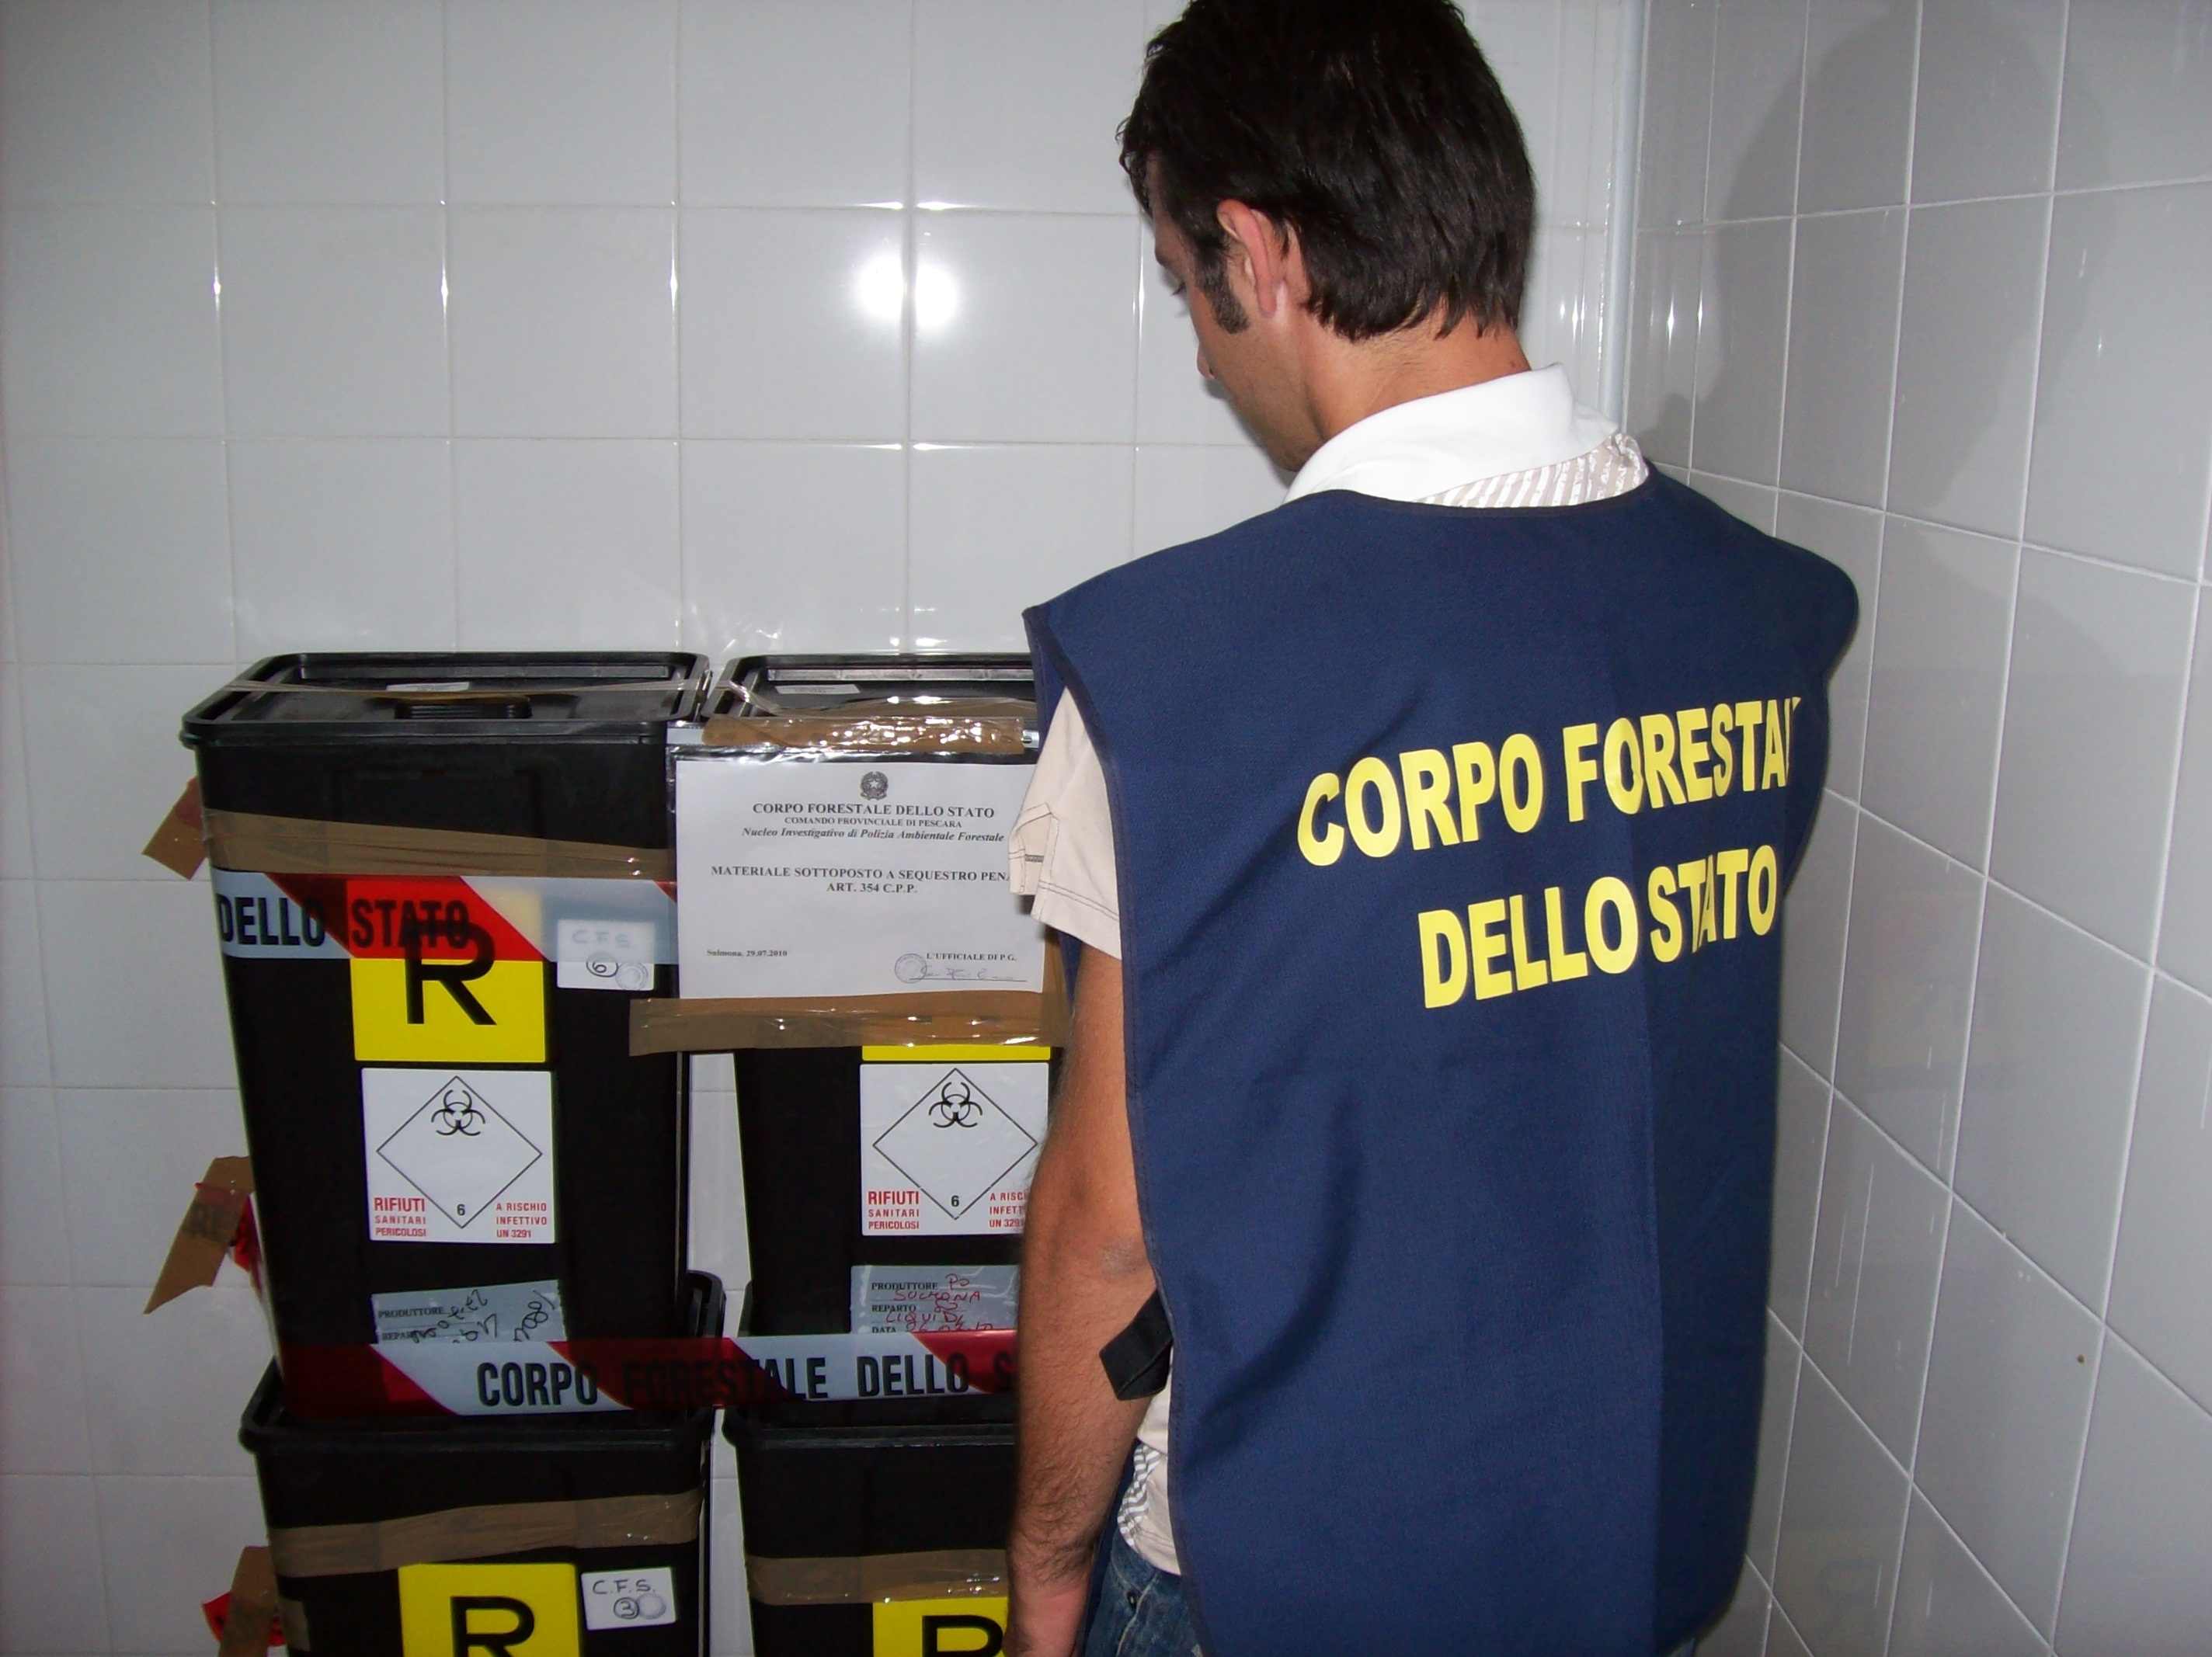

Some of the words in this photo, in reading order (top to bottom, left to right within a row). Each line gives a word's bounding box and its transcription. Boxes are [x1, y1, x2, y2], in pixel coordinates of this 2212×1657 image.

[1298, 733, 1543, 866] CORPO
[1563, 696, 1802, 822] FORESTA
[753, 803, 803, 815] CORPO
[808, 804, 892, 815] FORESTALE
[896, 805, 944, 817] DELLO
[948, 806, 995, 818] STATO
[784, 817, 836, 825] COMANDO
[837, 818, 903, 827] PROVINCIALE
[918, 819, 962, 828] PESCARA
[742, 827, 777, 837] Nucleo
[781, 828, 845, 839] Investigativo
[847, 828, 857, 839] di
[861, 829, 894, 840] Polizia
[898, 830, 955, 841] Ambientale
[958, 832, 1005, 842] Forestale
[711, 865, 791, 877] MATERIALE
[795, 867, 882, 879] SOTTOPOSTO
[886, 869, 894, 879] A
[899, 870, 977, 881] SEQUESTRO
[826, 882, 856, 892] ART.
[860, 883, 879, 893] 354
[883, 884, 918, 894] C.P.P.
[218, 895, 326, 947] DELLO
[352, 898, 471, 949] STATO
[1417, 876, 1638, 1009] DELLO
[1649, 845, 1778, 964] STATO
[404, 919, 497, 1026] R
[868, 1190, 920, 1204] RIFIUTI
[951, 1196, 959, 1207] 6
[989, 1192, 996, 1200] A
[374, 1197, 426, 1212] RIFIUTI
[457, 1204, 465, 1216] 6
[496, 1203, 503, 1211] A
[506, 1203, 547, 1212] RISCHIO
[868, 1209, 920, 1218] SANITARI
[375, 1215, 426, 1225] SANITARI
[496, 1217, 548, 1225] INFETTIVO
[868, 1221, 920, 1230] PERICOLOSI
[989, 1219, 1001, 1228] UN
[375, 1227, 426, 1237] PERICOLOSI
[496, 1229, 510, 1238] UN
[511, 1229, 532, 1238] 3291
[871, 1282, 938, 1291] PRODUTTORE
[378, 1306, 444, 1319] PRODUTTORE
[477, 1362, 598, 1407] CORPO
[857, 1353, 970, 1397] DELLO
[621, 1600, 632, 1617] 3
